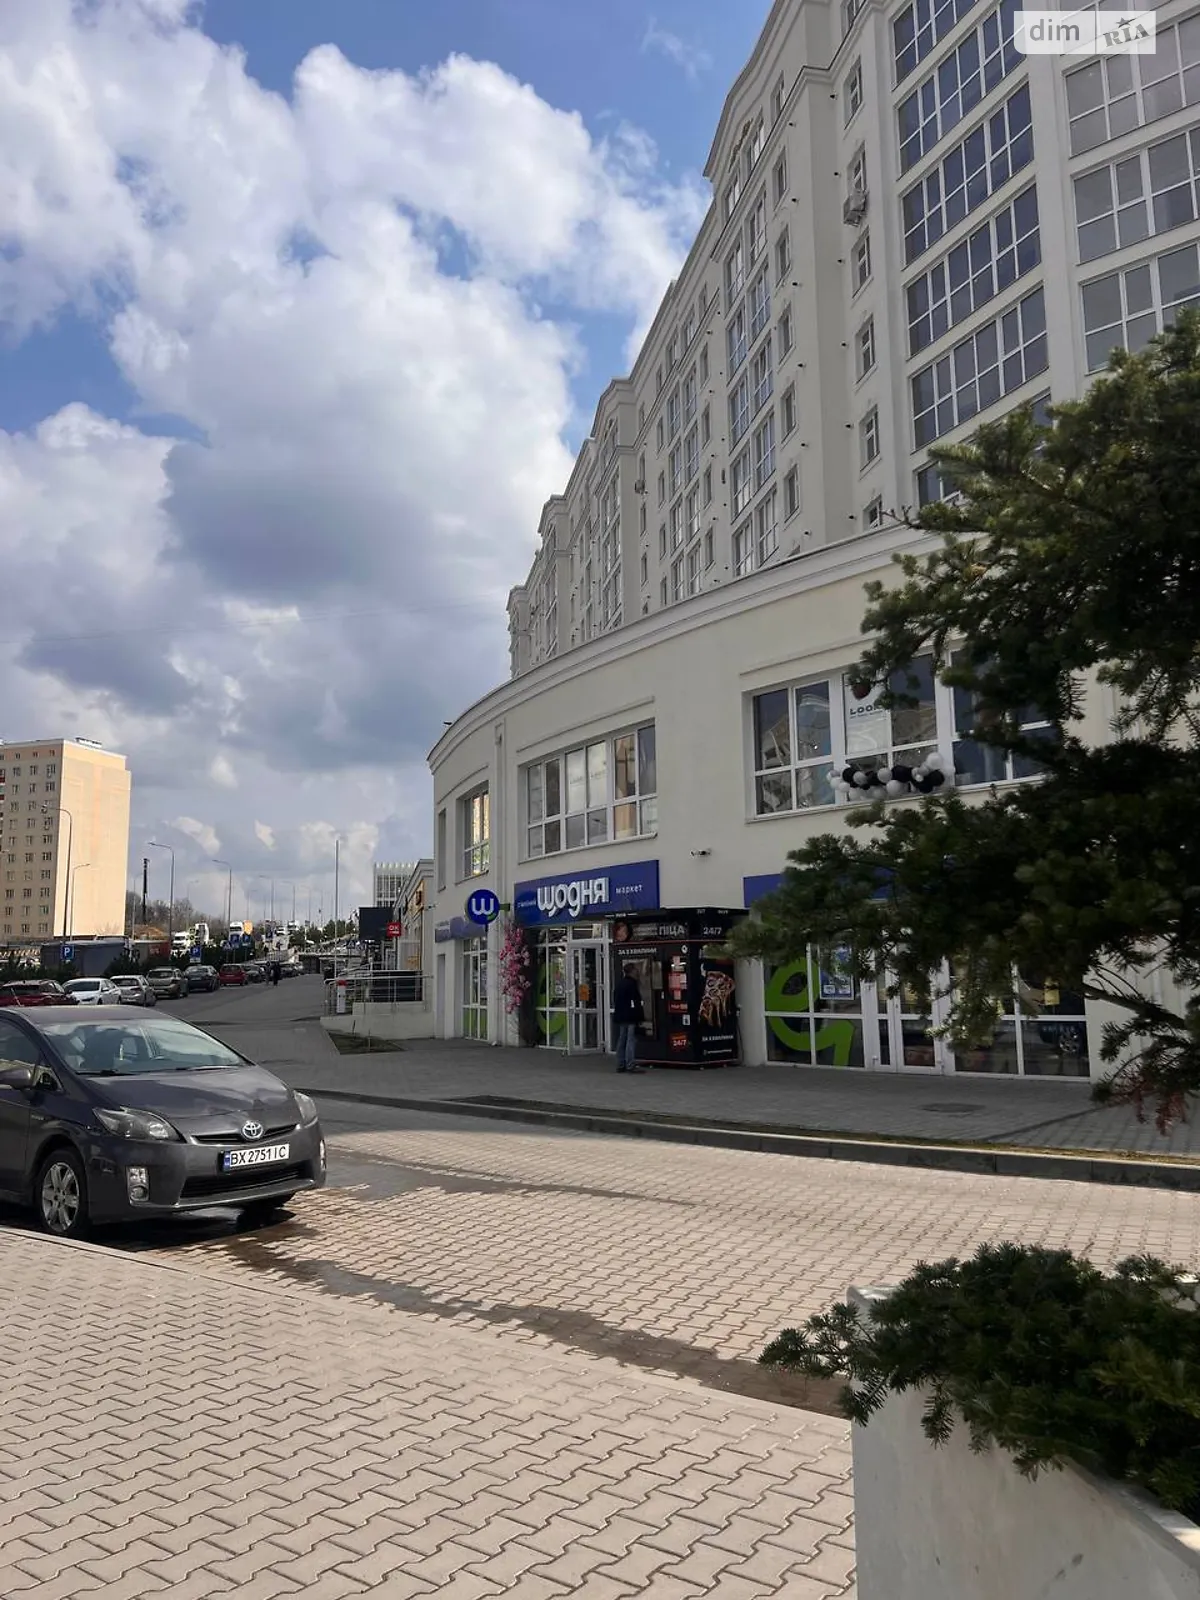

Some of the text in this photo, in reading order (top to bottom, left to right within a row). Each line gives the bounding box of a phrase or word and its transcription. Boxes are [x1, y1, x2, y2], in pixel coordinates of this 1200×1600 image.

[850, 704, 879, 715] LOO
[615, 884, 643, 896] маркет
[658, 925, 685, 938] ПІЦА
[703, 926, 722, 936] 24/7
[64, 947, 71, 959] P
[192, 946, 199, 956] P
[231, 1146, 286, 1166] BX 2751 IC
